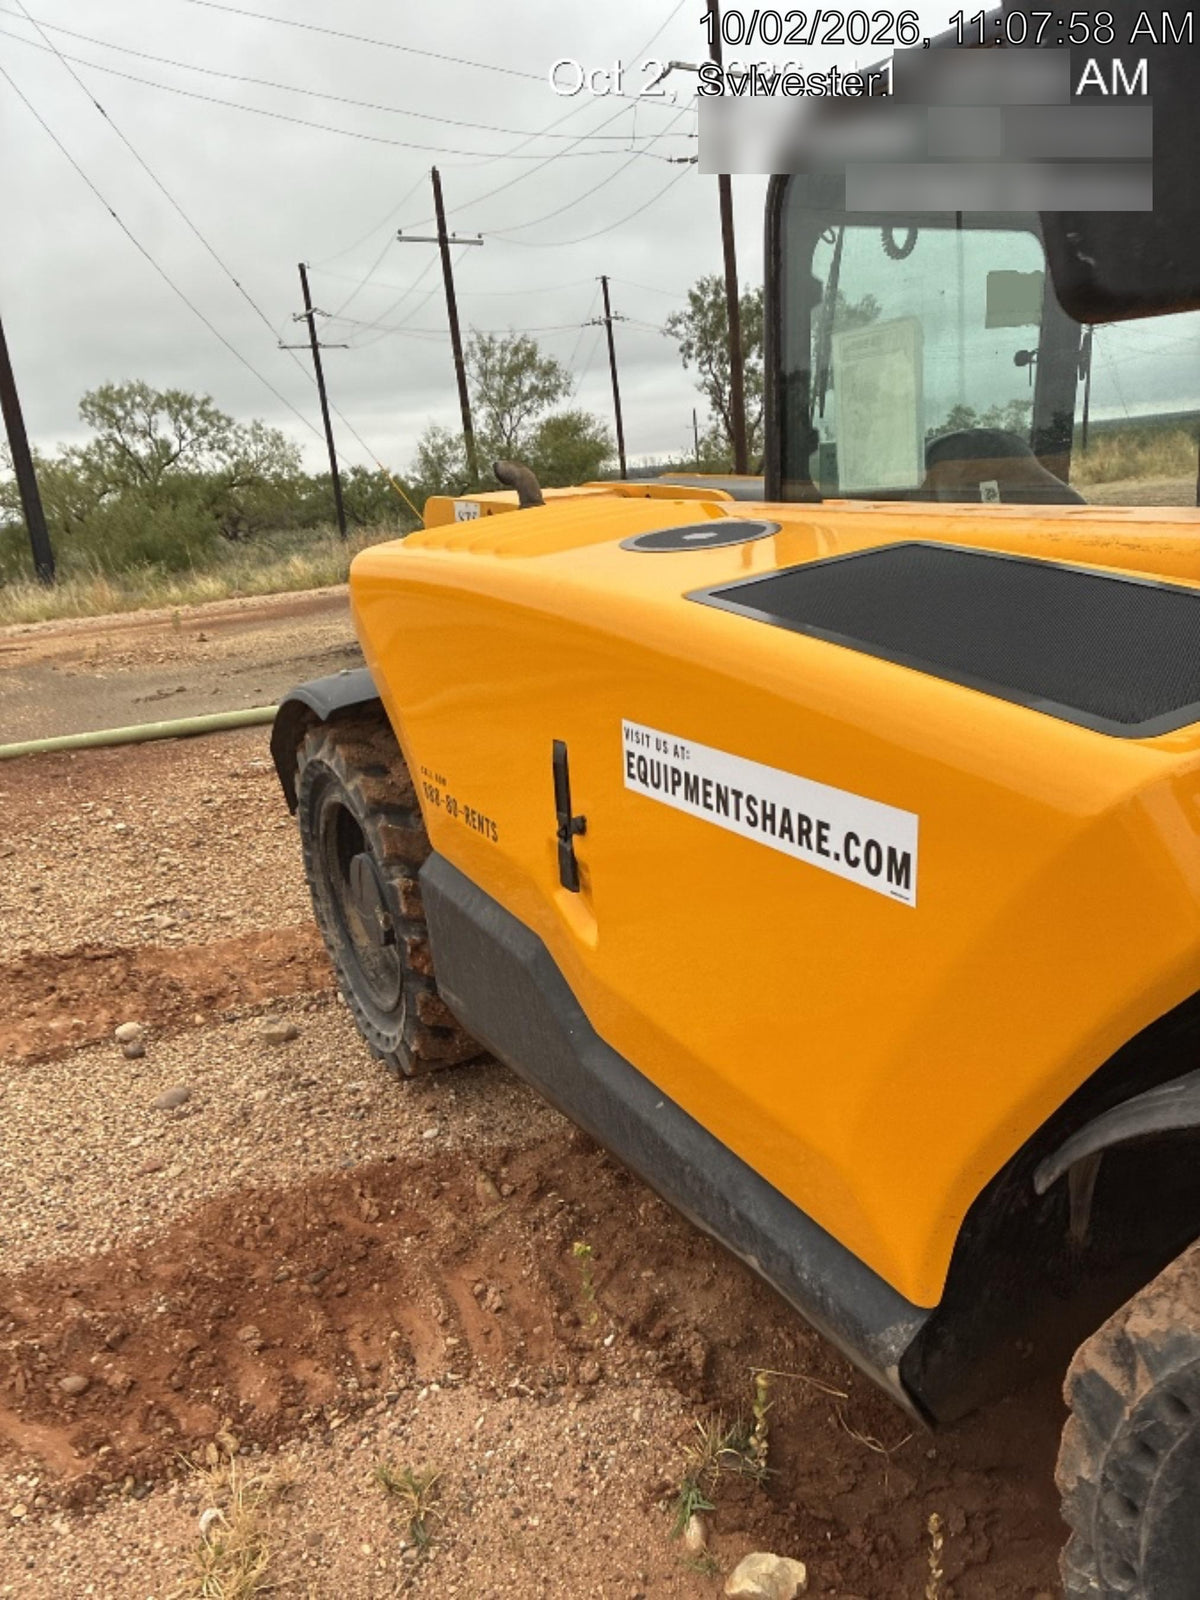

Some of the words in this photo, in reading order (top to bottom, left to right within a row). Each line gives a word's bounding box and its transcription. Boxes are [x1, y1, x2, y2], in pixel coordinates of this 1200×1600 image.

[624, 727, 650, 748] VISIT
[656, 737, 669, 755] US
[673, 744, 691, 760] AT:
[626, 749, 911, 890] EQUIPMENTSHARE.COM
